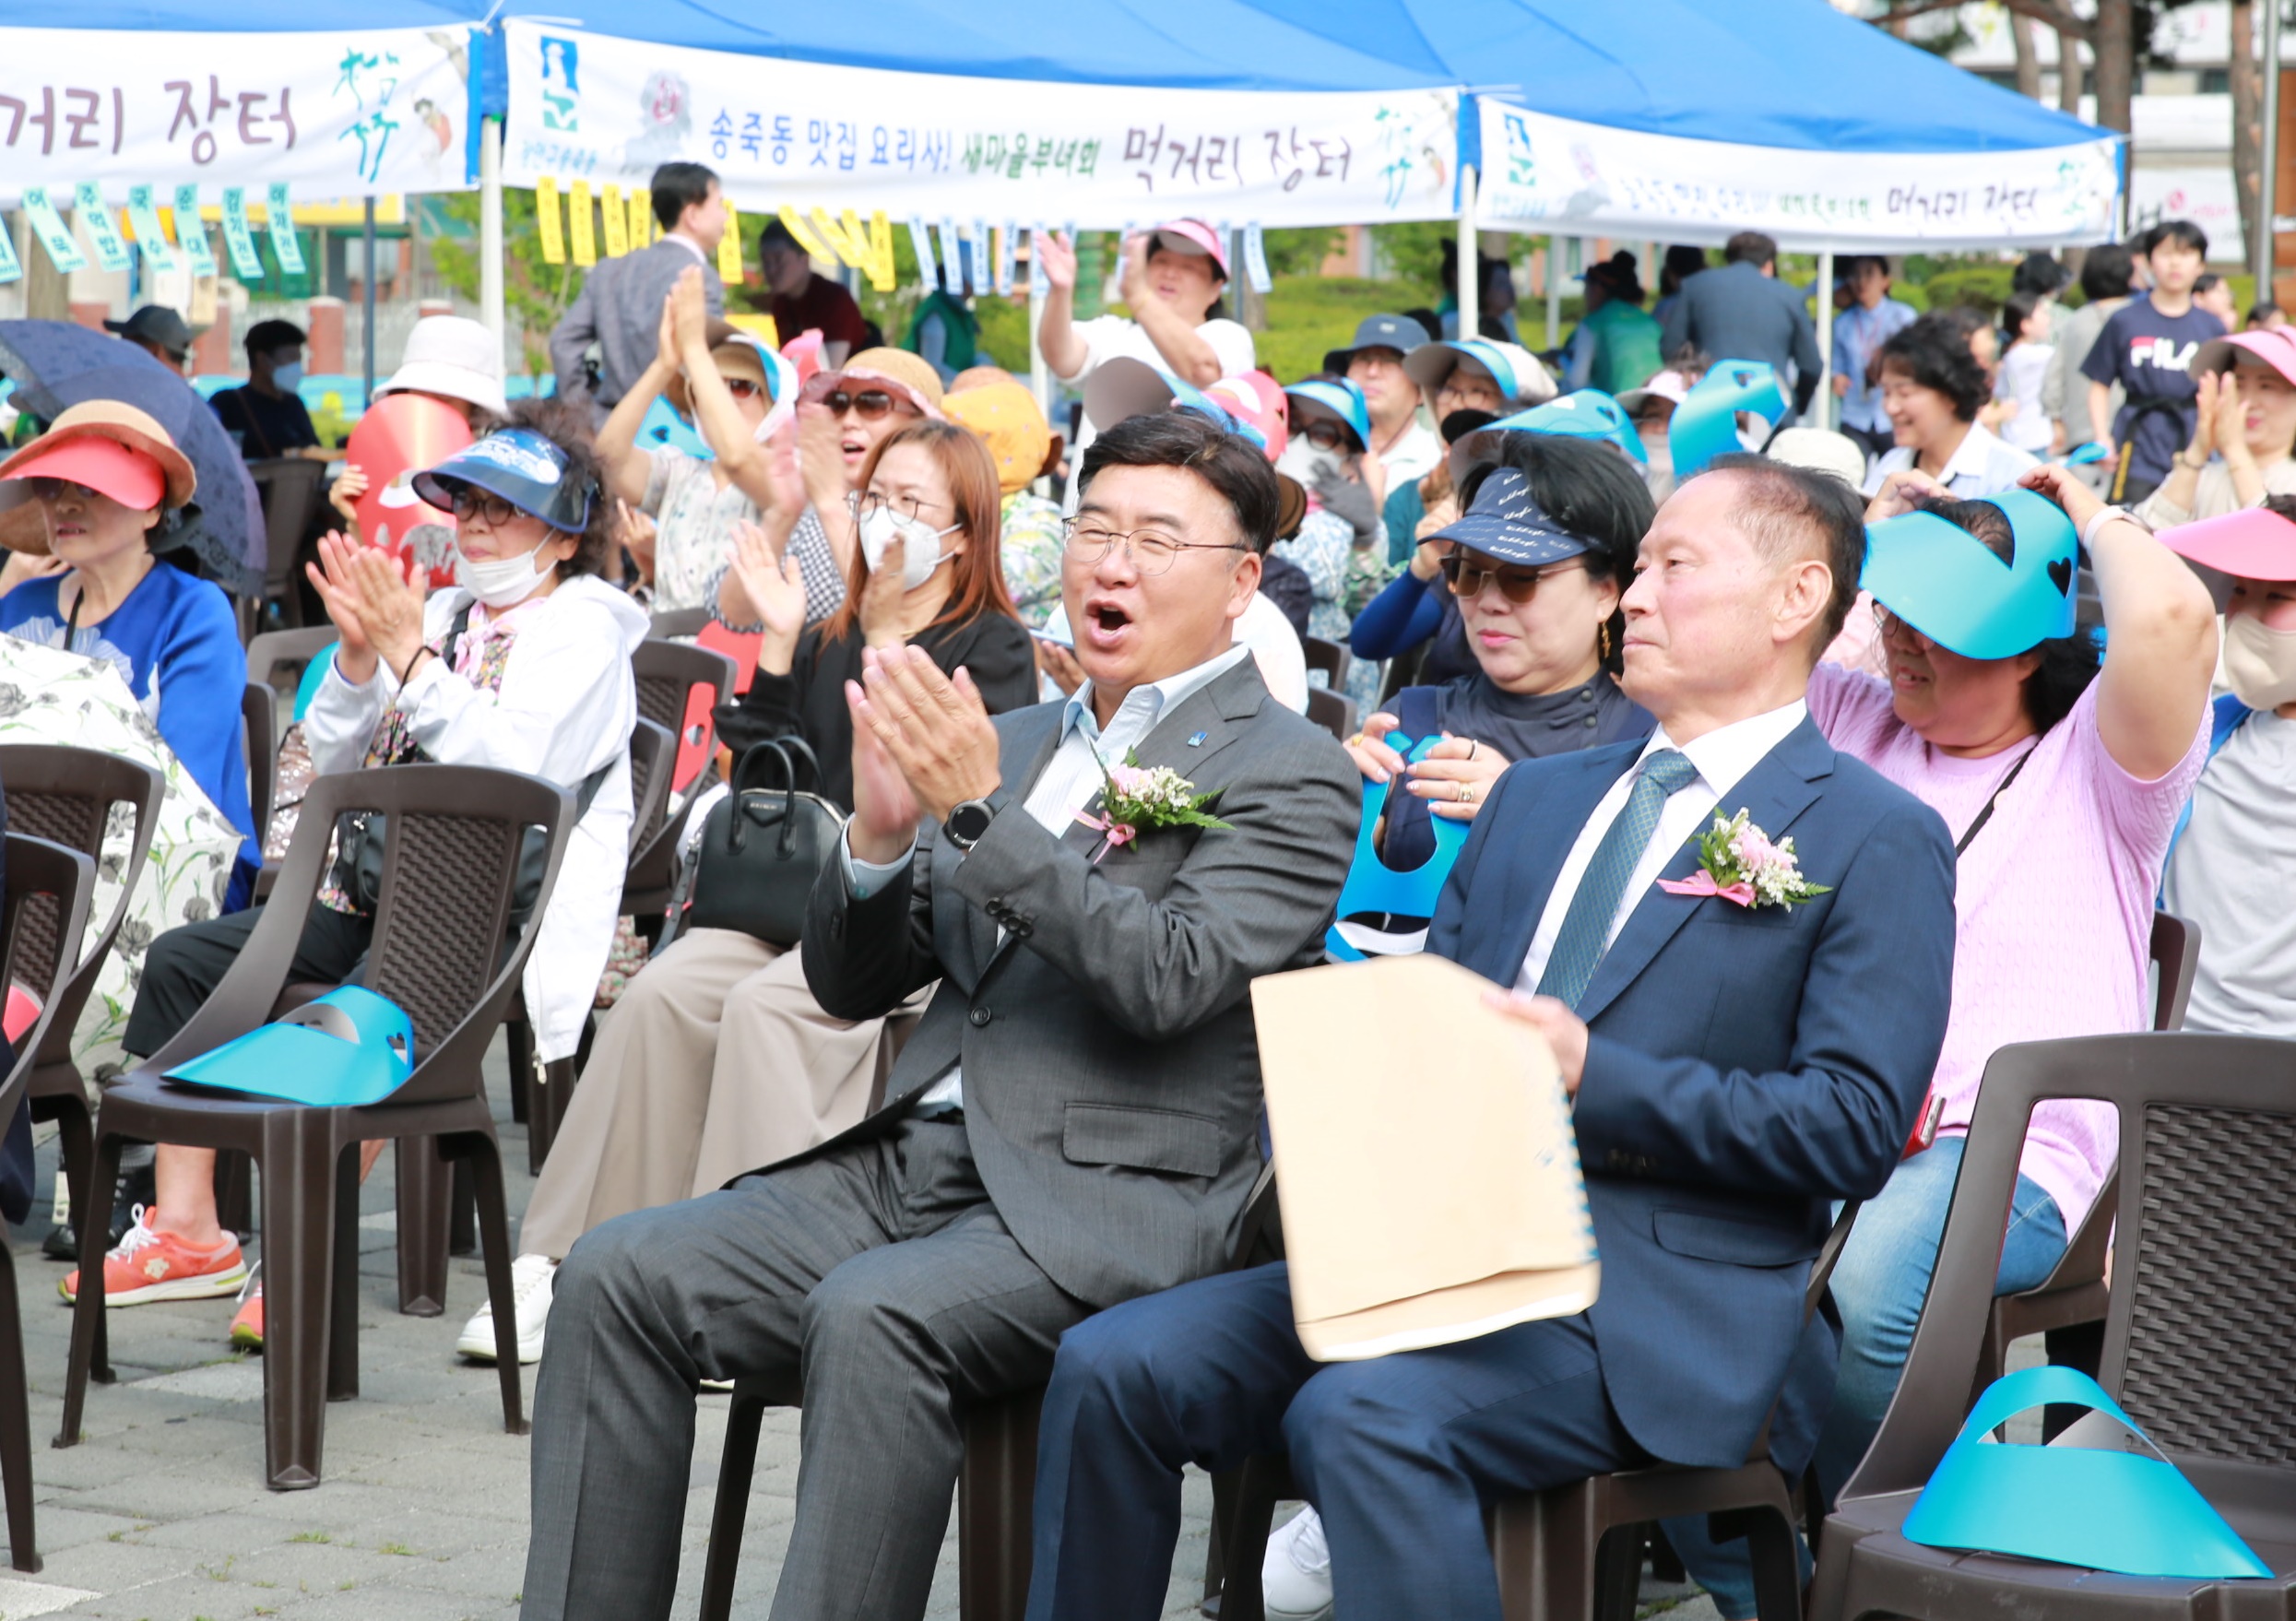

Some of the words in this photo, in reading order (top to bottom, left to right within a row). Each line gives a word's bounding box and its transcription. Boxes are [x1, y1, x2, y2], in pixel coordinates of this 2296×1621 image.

[163, 74, 297, 165] 장터
[709, 107, 794, 167] 송죽동
[809, 119, 858, 171] 맛집
[870, 127, 953, 173] 요리사!
[961, 132, 1102, 180] 새마을부녀회
[1123, 123, 1245, 193] 먹거리
[1264, 126, 1352, 193] 장터
